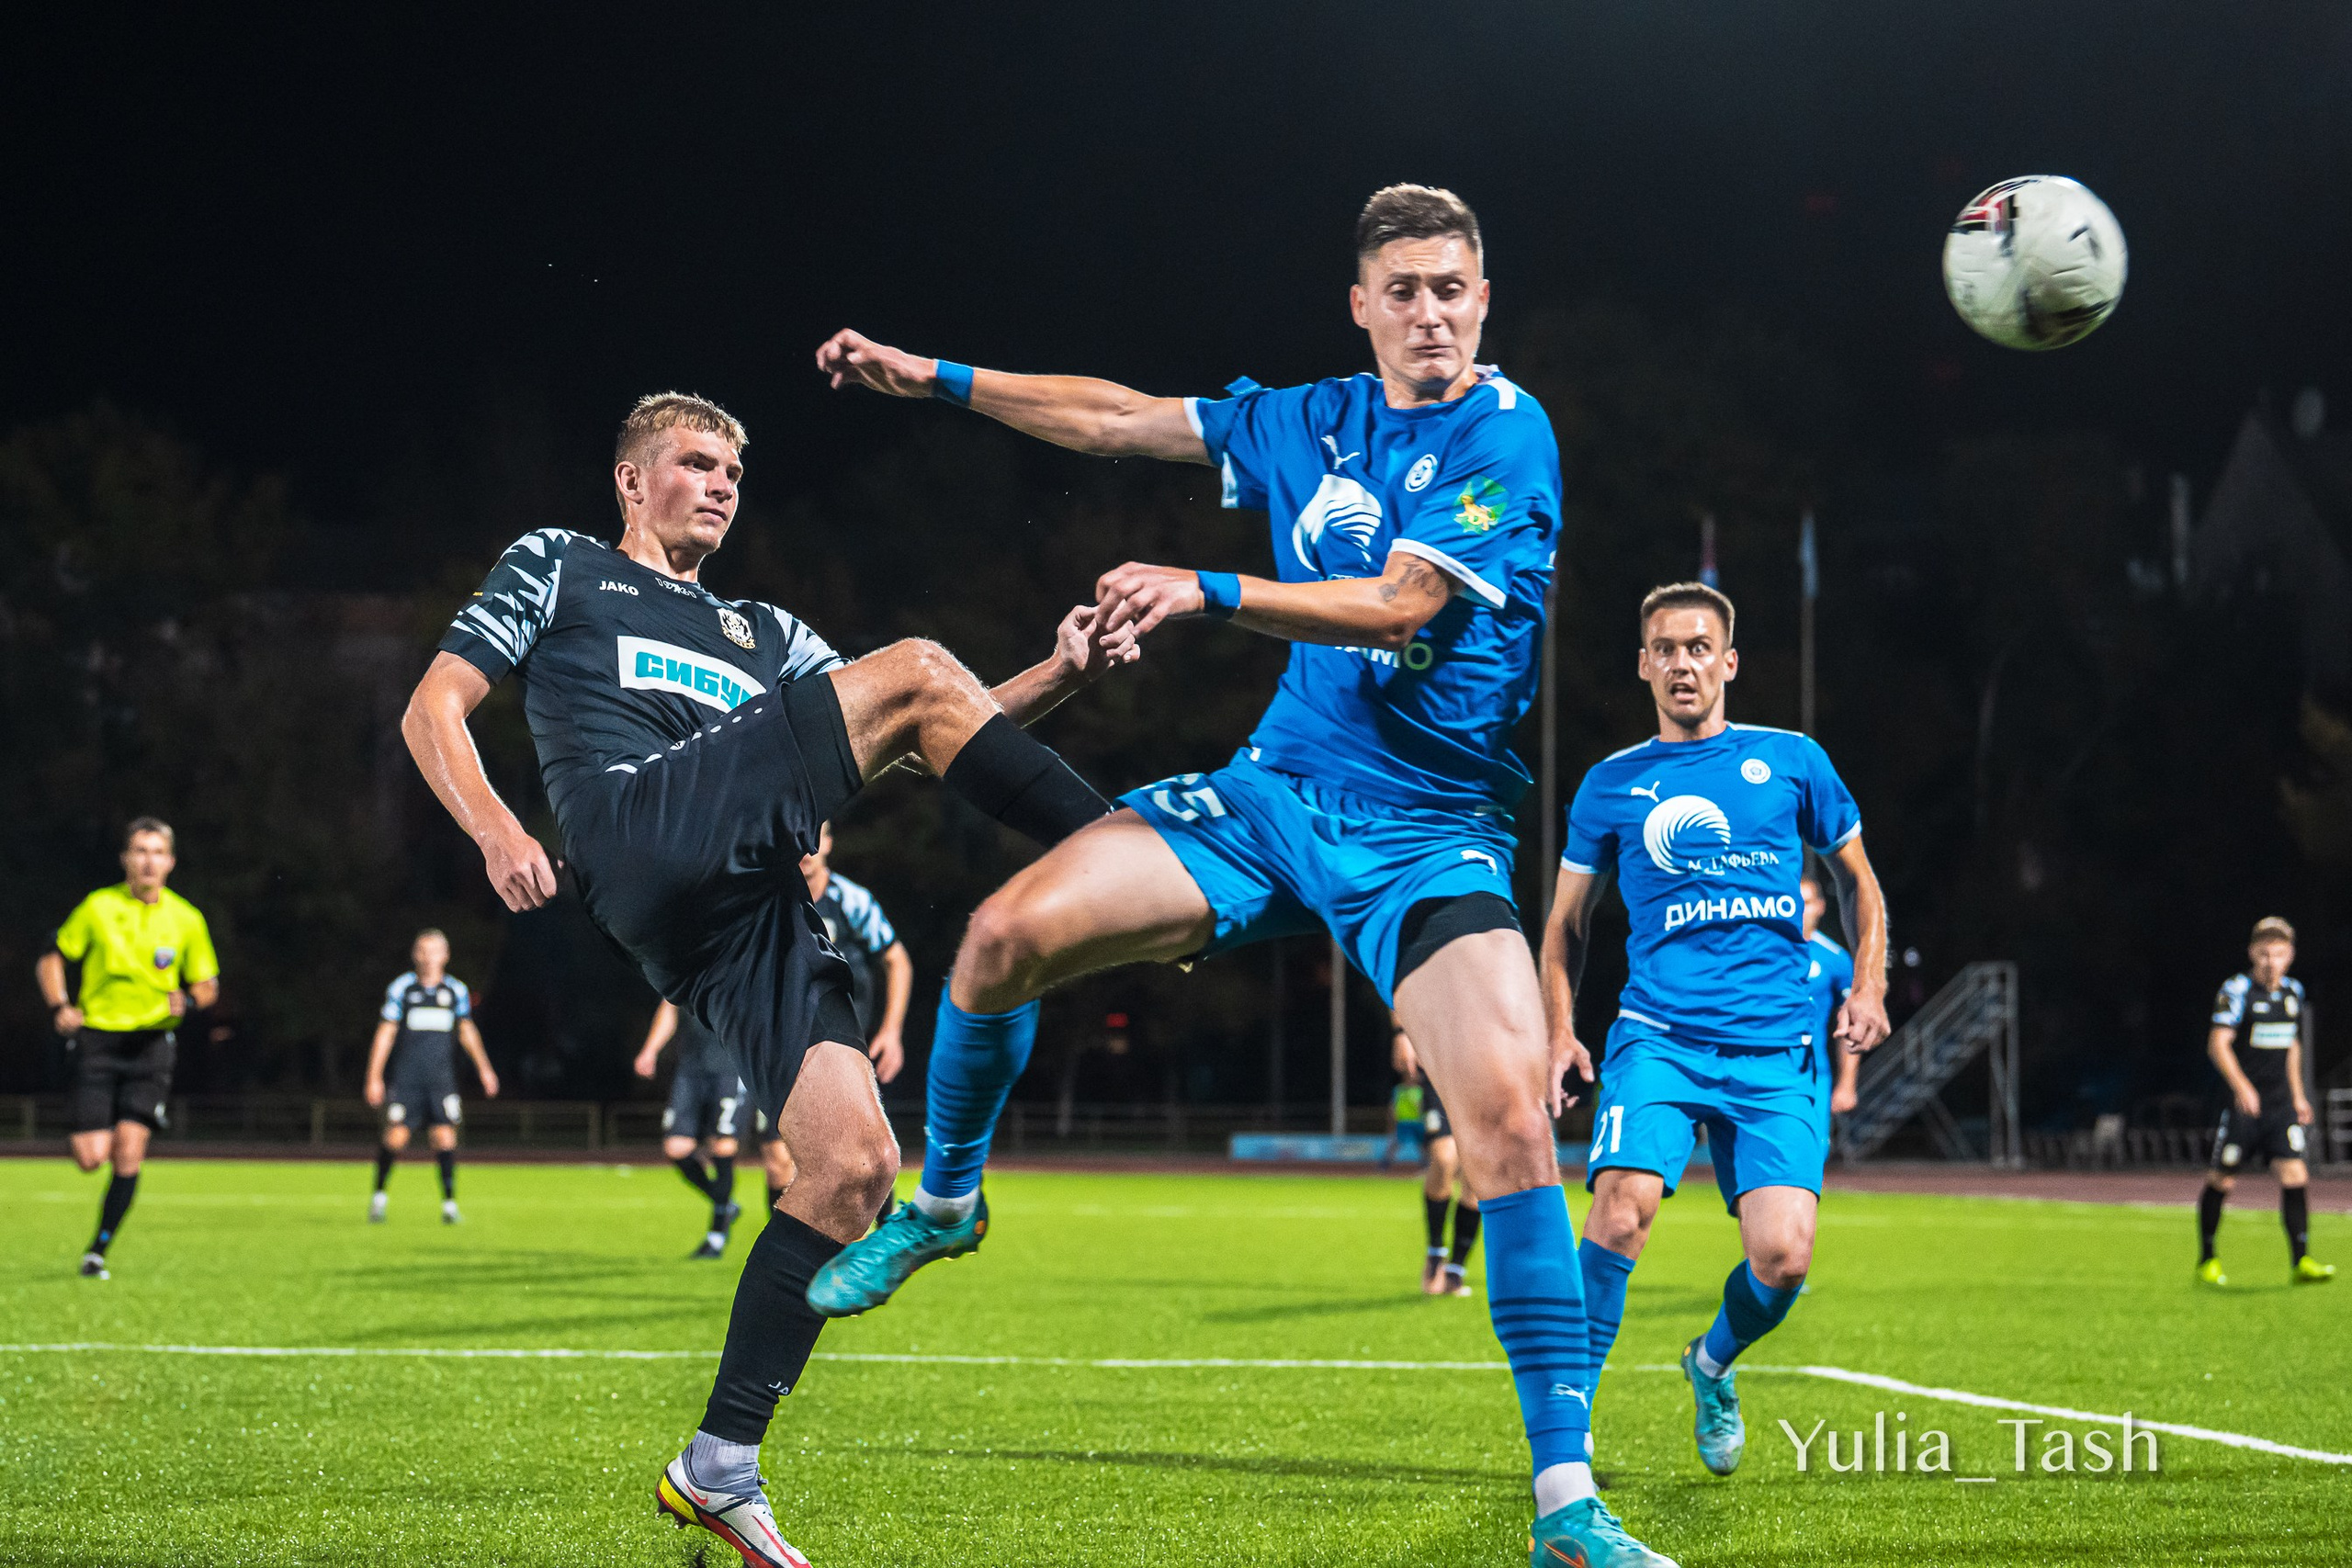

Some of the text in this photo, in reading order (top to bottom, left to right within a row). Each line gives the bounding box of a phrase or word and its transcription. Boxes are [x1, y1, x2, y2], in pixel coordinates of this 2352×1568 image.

[599, 581, 639, 596] JAKO
[1664, 895, 1797, 931] ДИНАМО
[1589, 1105, 1624, 1163] 21
